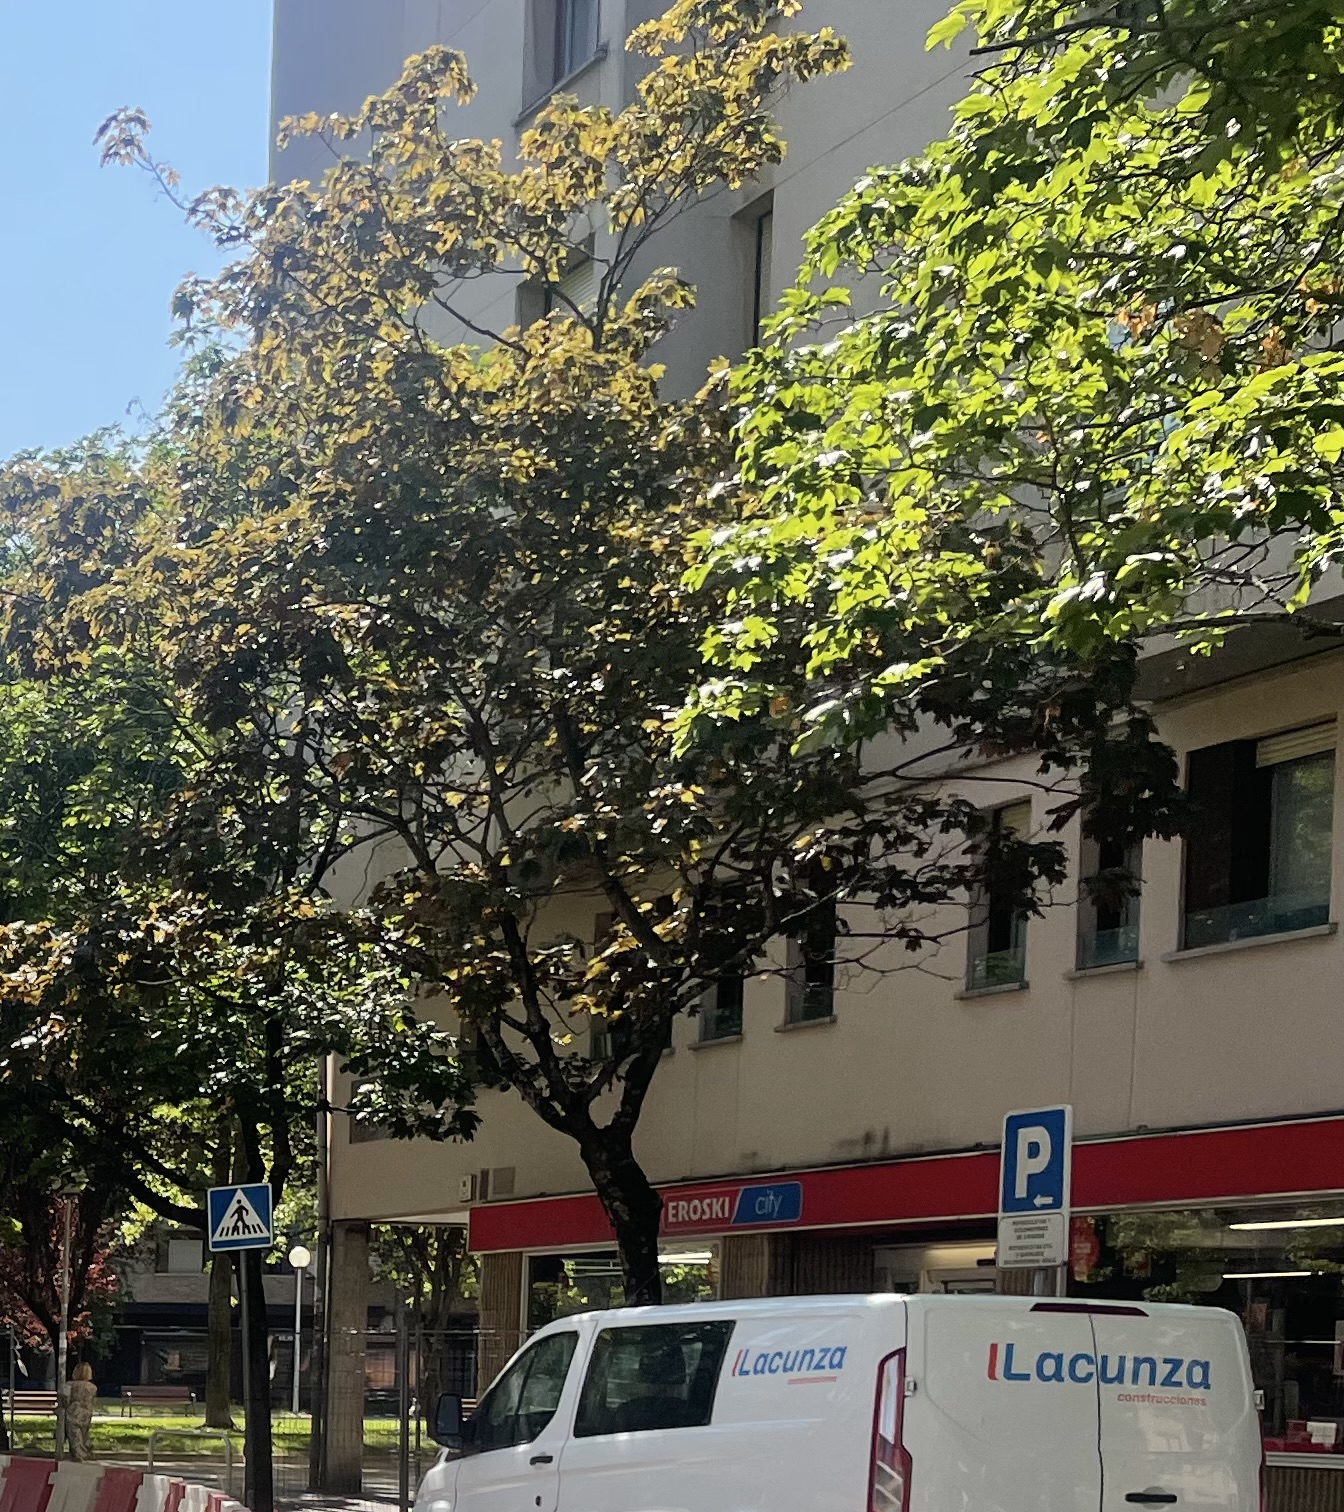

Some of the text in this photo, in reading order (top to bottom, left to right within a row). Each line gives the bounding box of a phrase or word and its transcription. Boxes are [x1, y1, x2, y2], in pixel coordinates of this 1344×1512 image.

[1015, 1126, 1051, 1198] P
[667, 1190, 783, 1223] EROSKI city
[1003, 1343, 1211, 1390] Lacunza
[1117, 1391, 1207, 1407] construcciones
